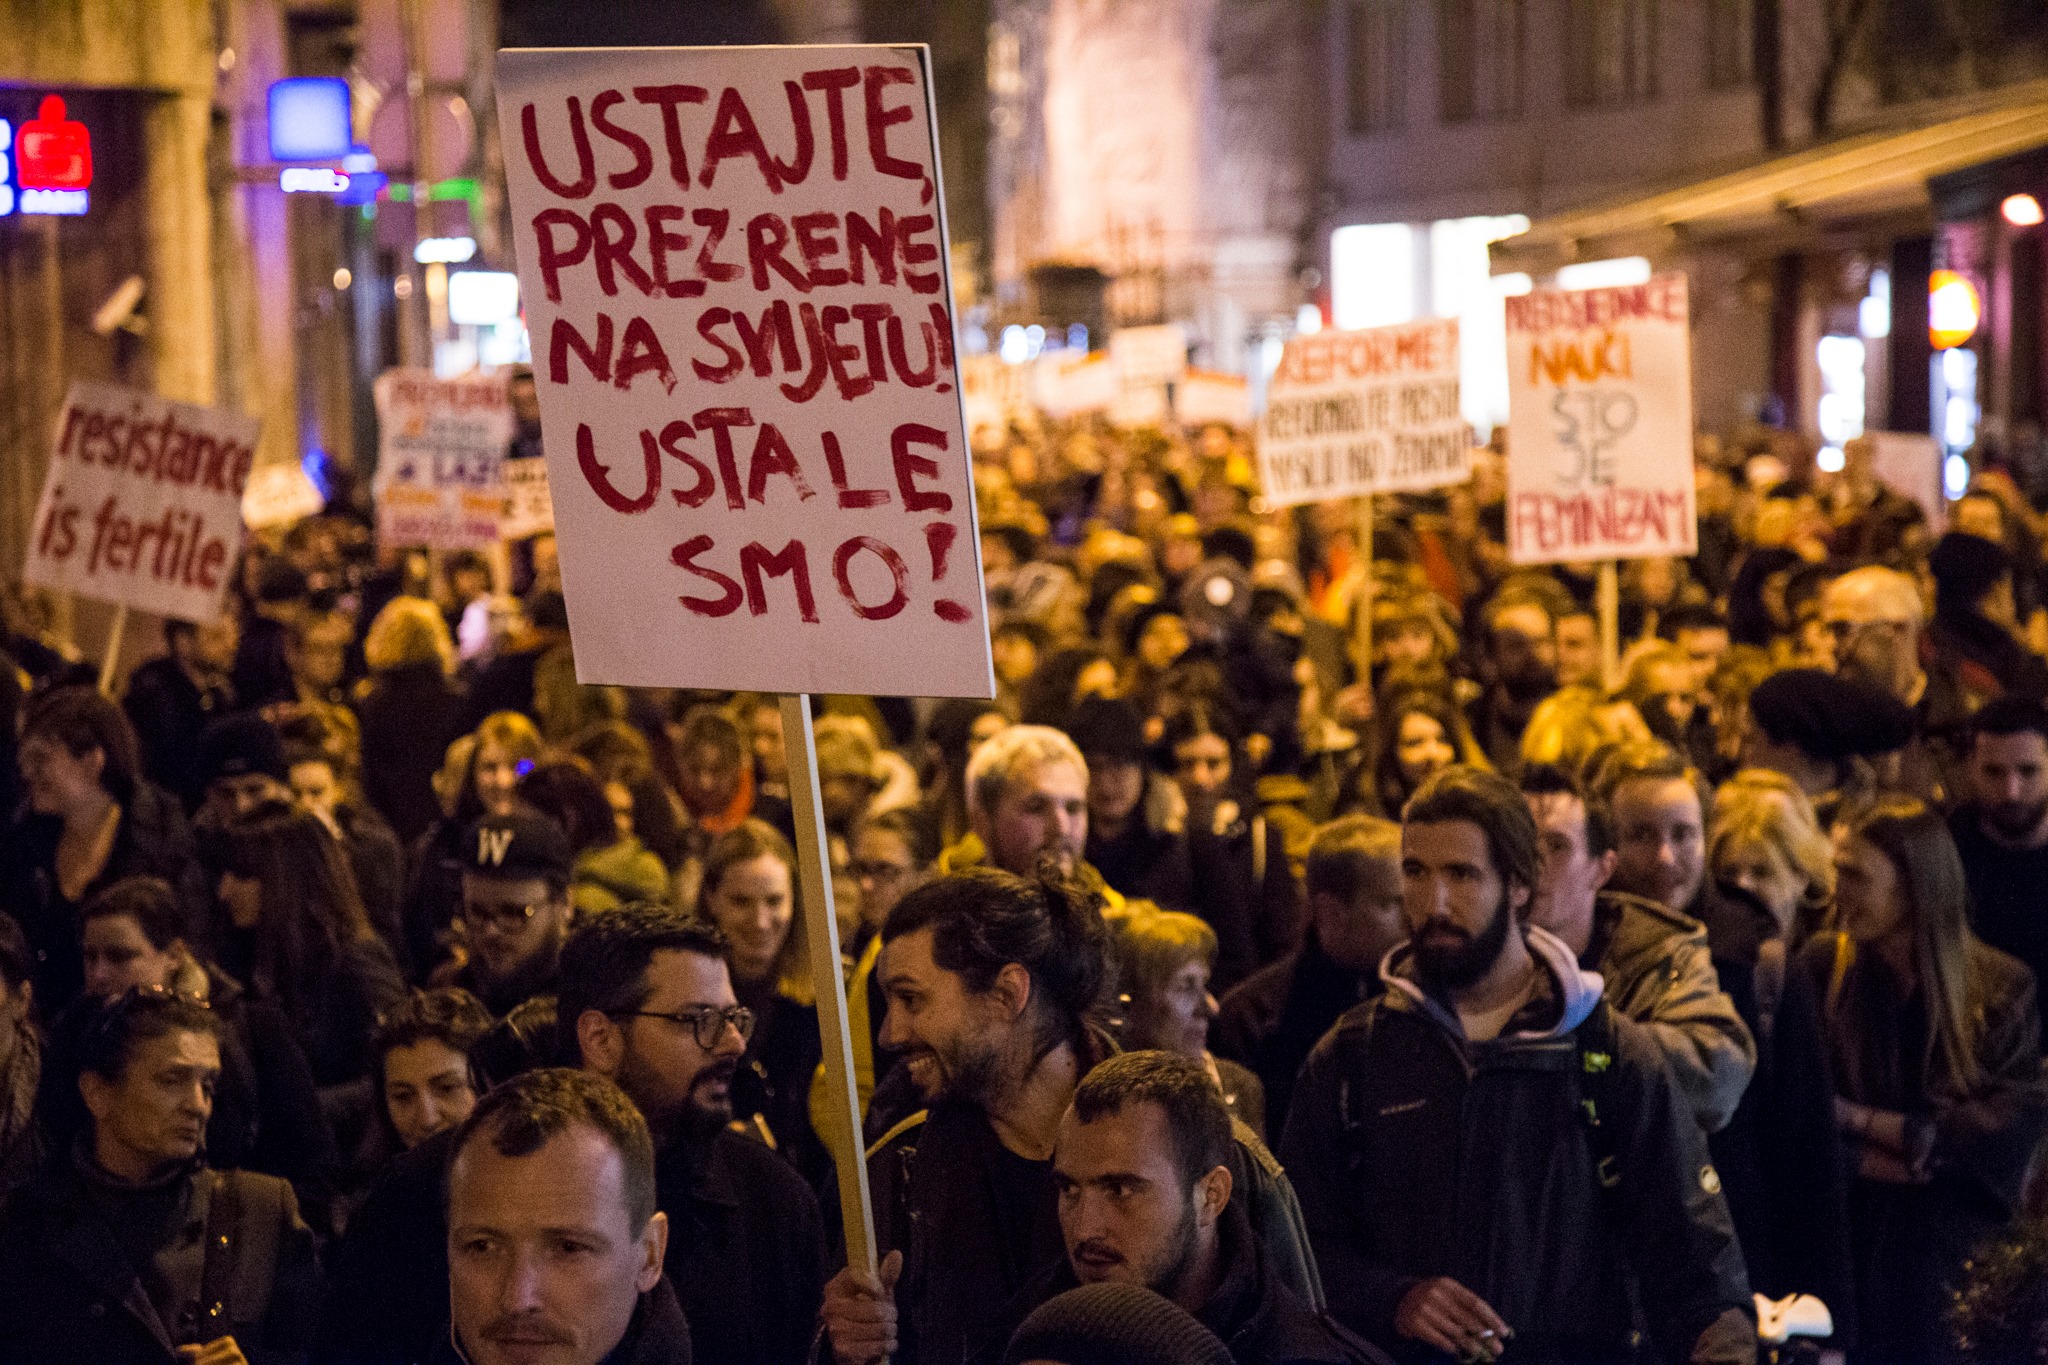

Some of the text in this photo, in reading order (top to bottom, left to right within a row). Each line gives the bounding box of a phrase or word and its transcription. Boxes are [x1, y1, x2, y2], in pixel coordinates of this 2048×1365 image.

[522, 66, 933, 205] USTAJTE,
[531, 202, 941, 304] PREZRENE
[549, 299, 953, 404] NA SVIJETU!
[59, 401, 253, 498] resistance
[576, 407, 953, 514] USTALE
[39, 485, 227, 590] is fertile
[669, 522, 973, 624] SMO!
[477, 827, 514, 867] W
